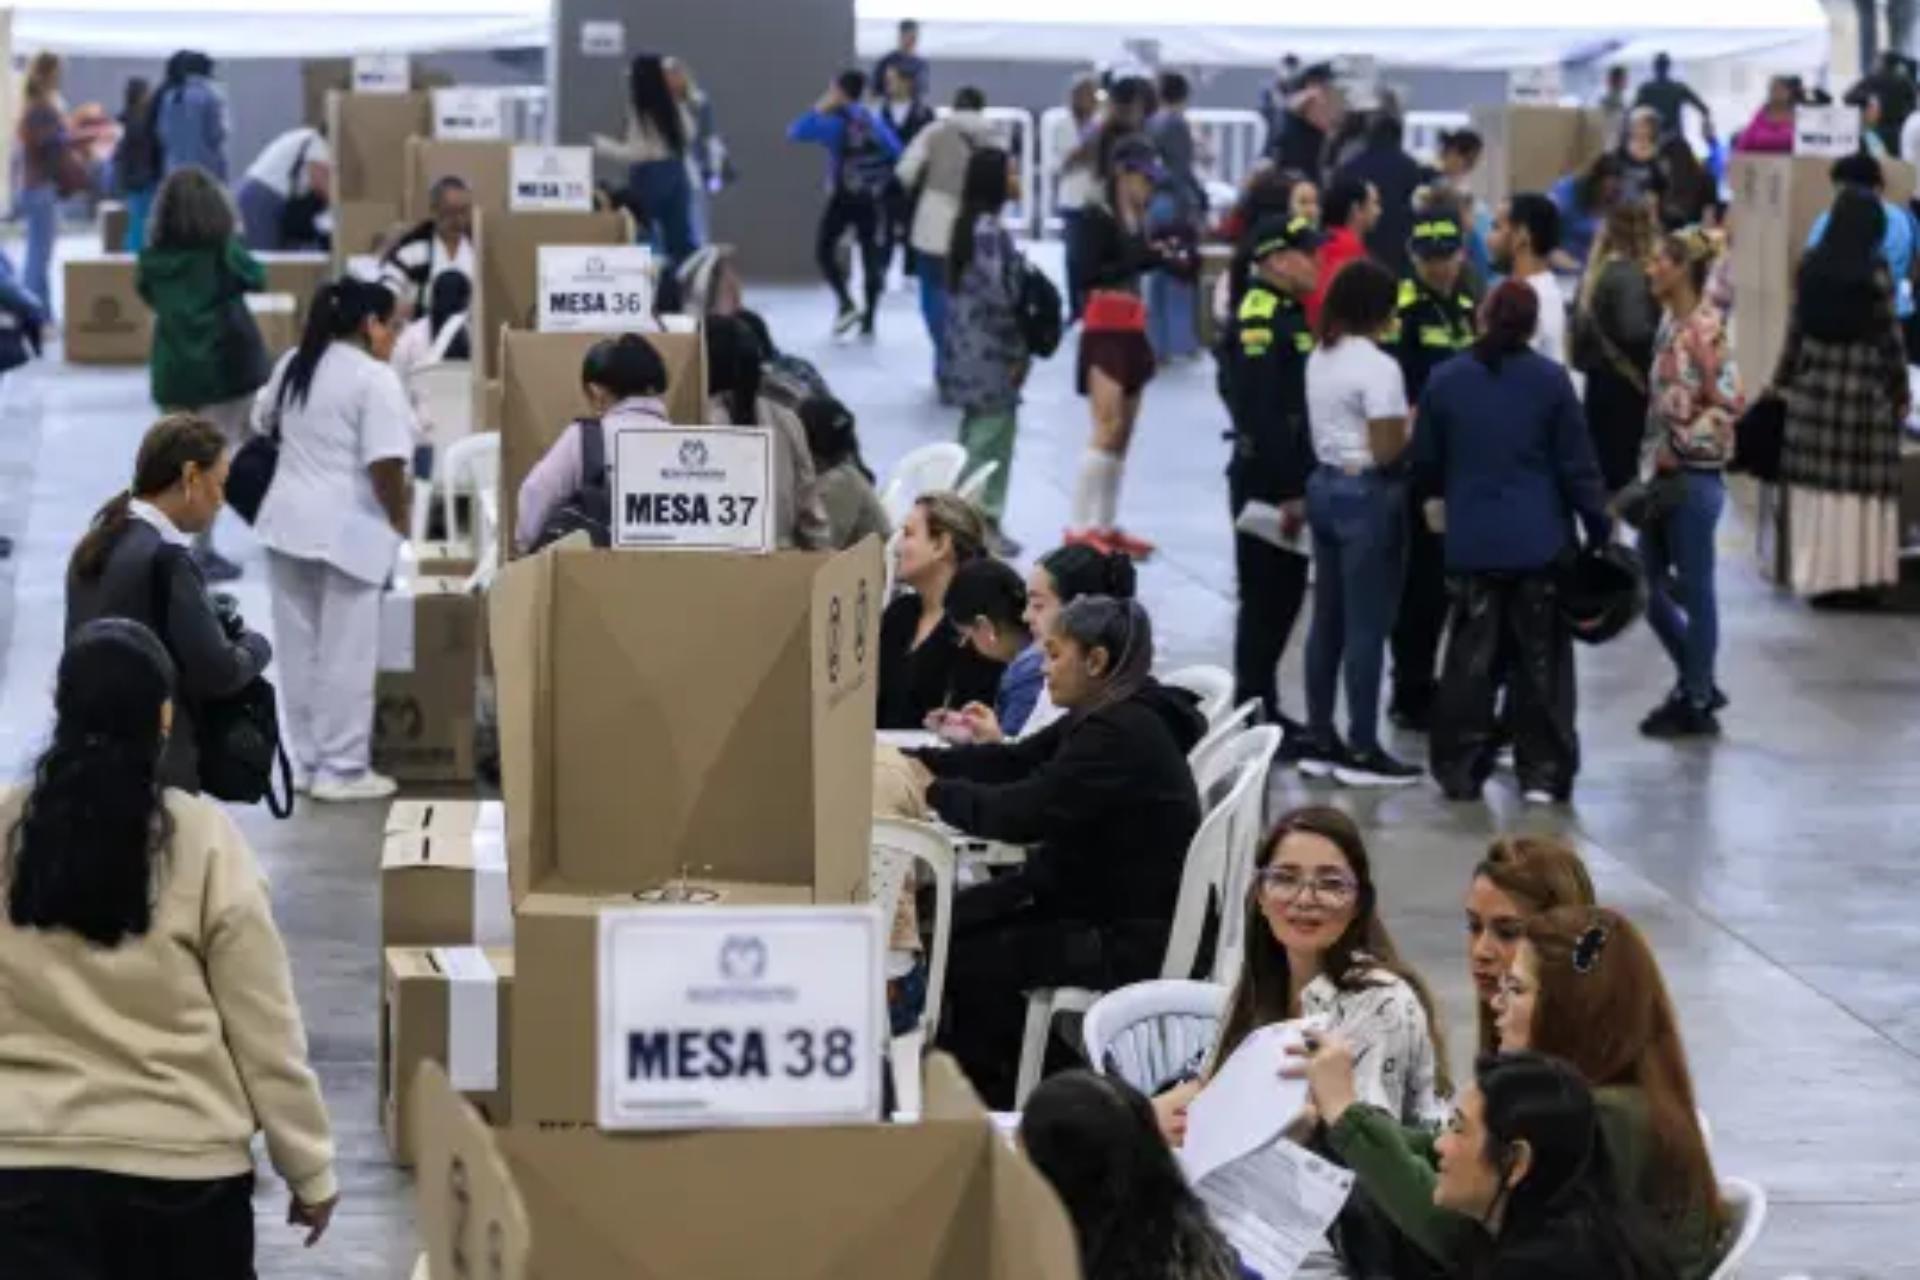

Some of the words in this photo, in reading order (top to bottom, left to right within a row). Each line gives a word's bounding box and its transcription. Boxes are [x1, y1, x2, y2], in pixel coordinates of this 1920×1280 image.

[550, 292, 606, 314] MESA
[611, 292, 641, 315] 36
[625, 493, 710, 526] MESA
[717, 495, 759, 526] 37
[627, 1029, 769, 1081] MESA
[784, 1028, 855, 1079] 38
